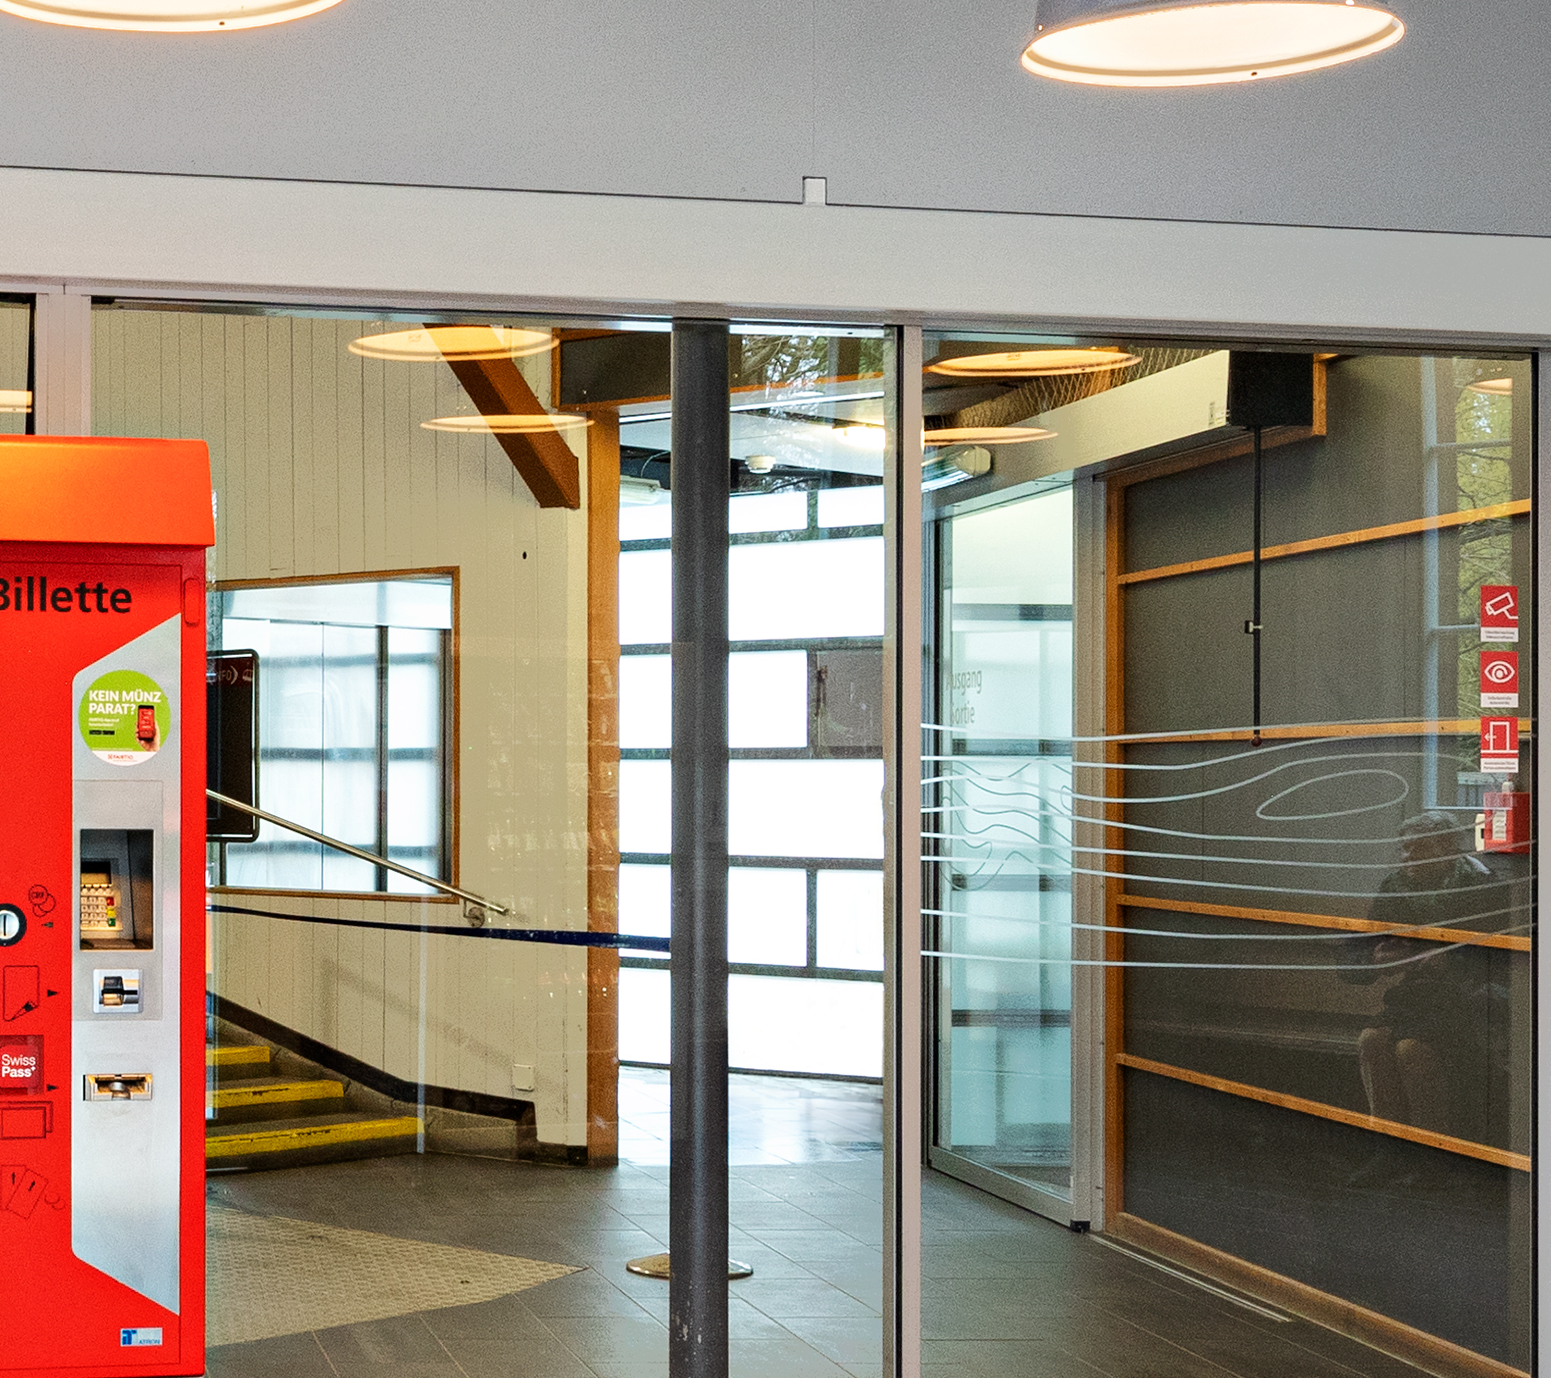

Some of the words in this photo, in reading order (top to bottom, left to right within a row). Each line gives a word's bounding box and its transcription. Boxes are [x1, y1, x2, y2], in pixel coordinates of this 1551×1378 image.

[89, 690, 119, 702] KEIN
[122, 689, 161, 703] MÜNZ
[89, 703, 136, 715] PARAT?
[1, 1053, 36, 1066] Swiss
[1, 1066, 32, 1078] Pass
